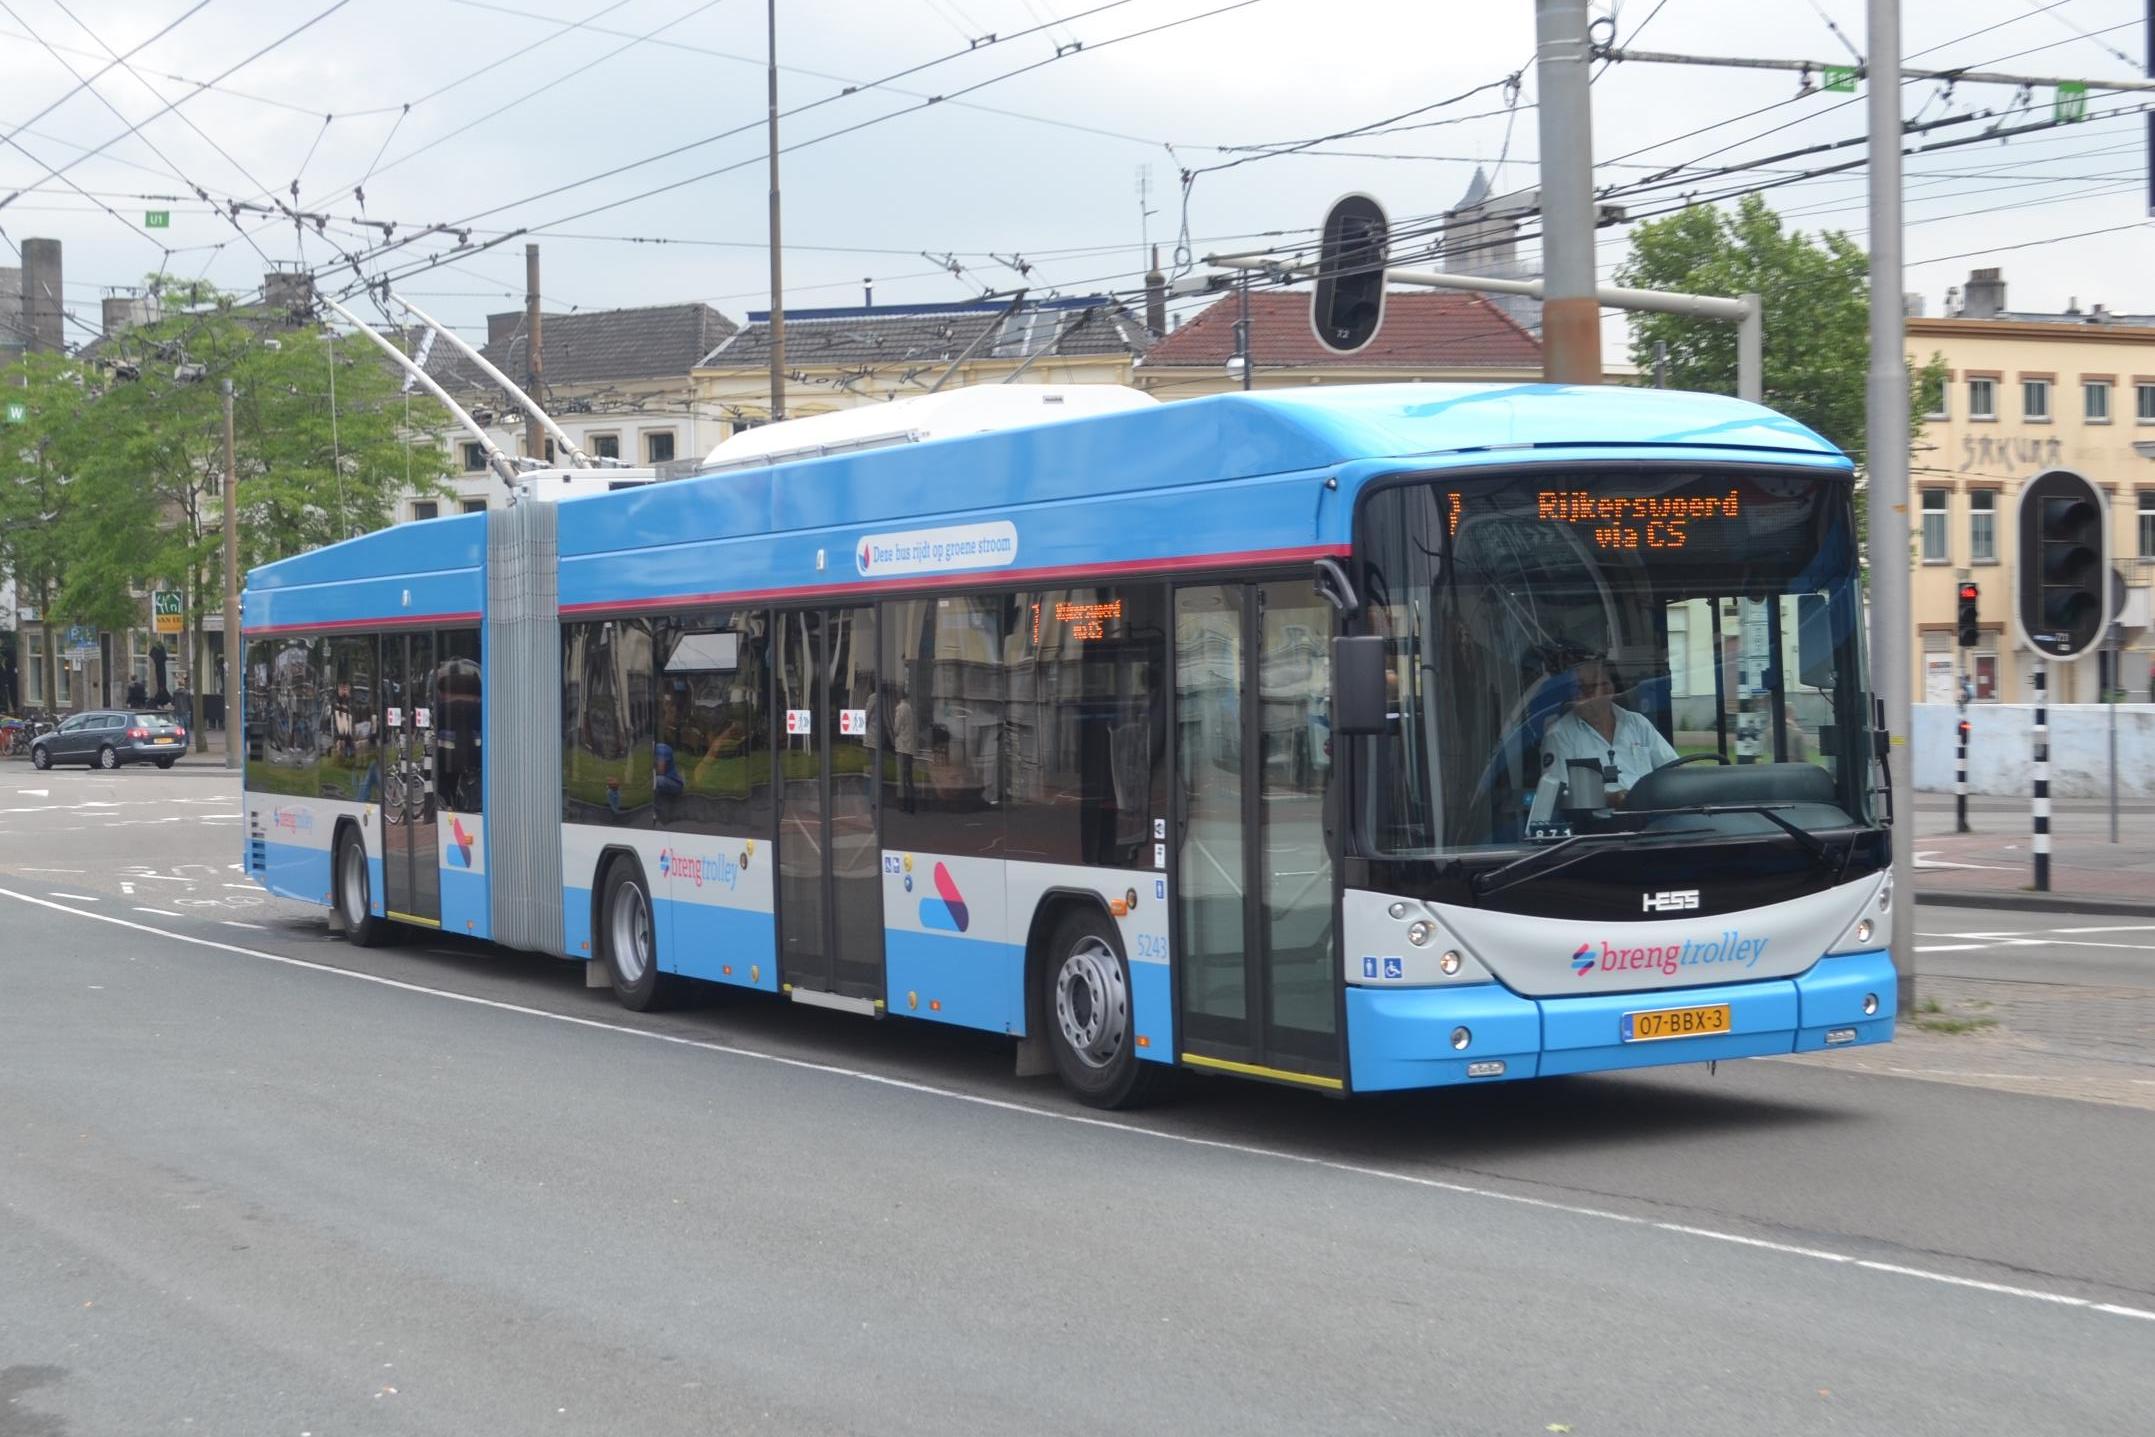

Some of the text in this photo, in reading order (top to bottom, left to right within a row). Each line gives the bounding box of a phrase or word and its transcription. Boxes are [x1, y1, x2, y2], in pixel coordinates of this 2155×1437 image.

[10, 407, 23, 419] W
[1538, 489, 1740, 522] Rijkerswoerd
[1595, 520, 1687, 548] via CS
[873, 537, 1010, 563] Deze bus rijdt op groene stroom
[1642, 889, 1700, 912] HESS
[1137, 933, 1168, 958] 5243
[1601, 930, 1769, 975] brengtrolley
[1639, 1009, 1723, 1036] 07-BBX-3
